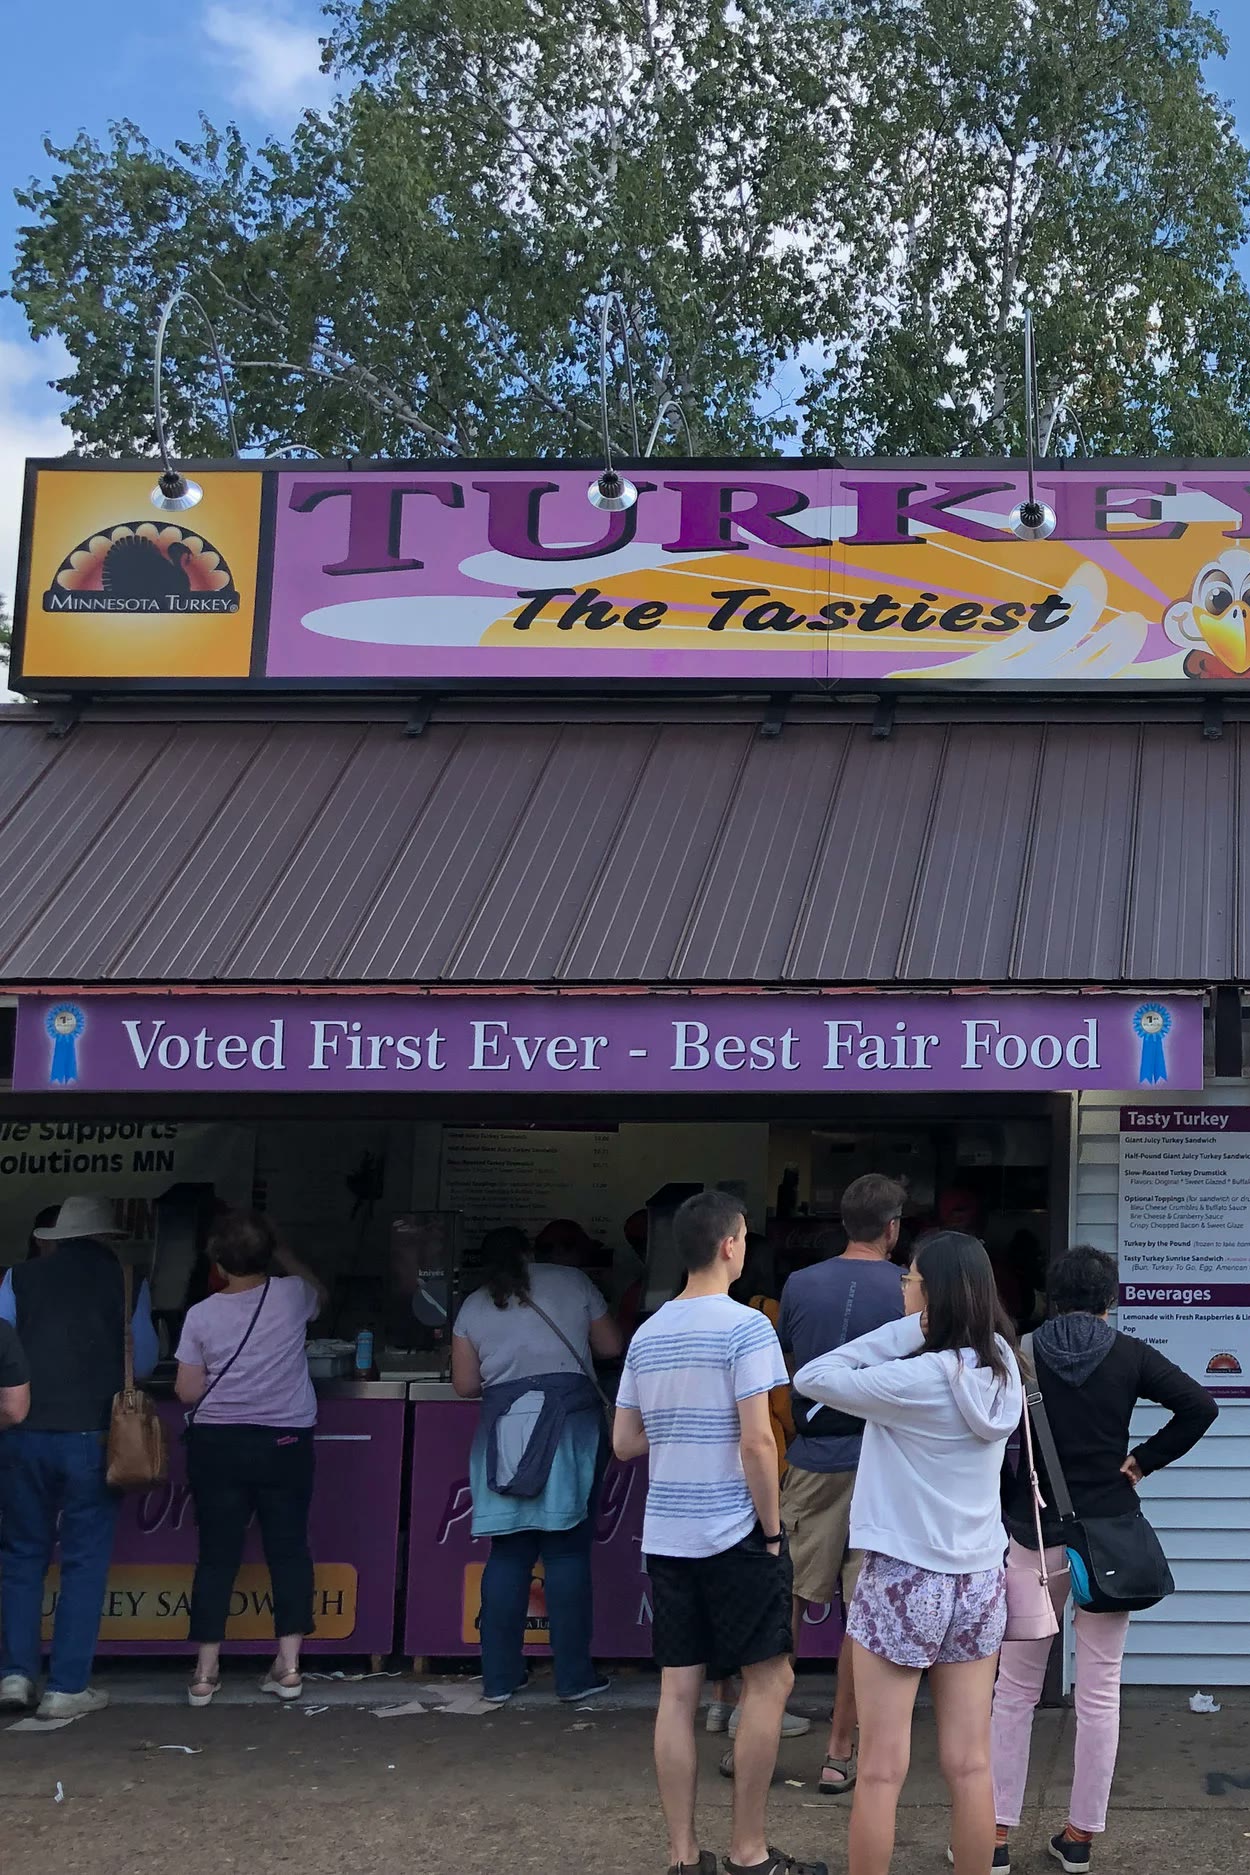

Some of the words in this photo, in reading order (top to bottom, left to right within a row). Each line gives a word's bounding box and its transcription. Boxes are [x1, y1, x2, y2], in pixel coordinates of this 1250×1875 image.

[512, 586, 667, 633] The
[707, 587, 1072, 633] Tastiest
[122, 1019, 286, 1071] Voted
[308, 1020, 447, 1071] First
[468, 1020, 608, 1071] Ever
[670, 1019, 800, 1071] Best
[822, 1019, 940, 1070] Fair
[961, 1018, 1101, 1070] Food
[1128, 1111, 1170, 1128] Tasty
[1174, 1111, 1229, 1128] Turkey
[133, 1150, 175, 1172] MN
[418, 1268, 445, 1277] knives
[1126, 1286, 1211, 1304] Beverages
